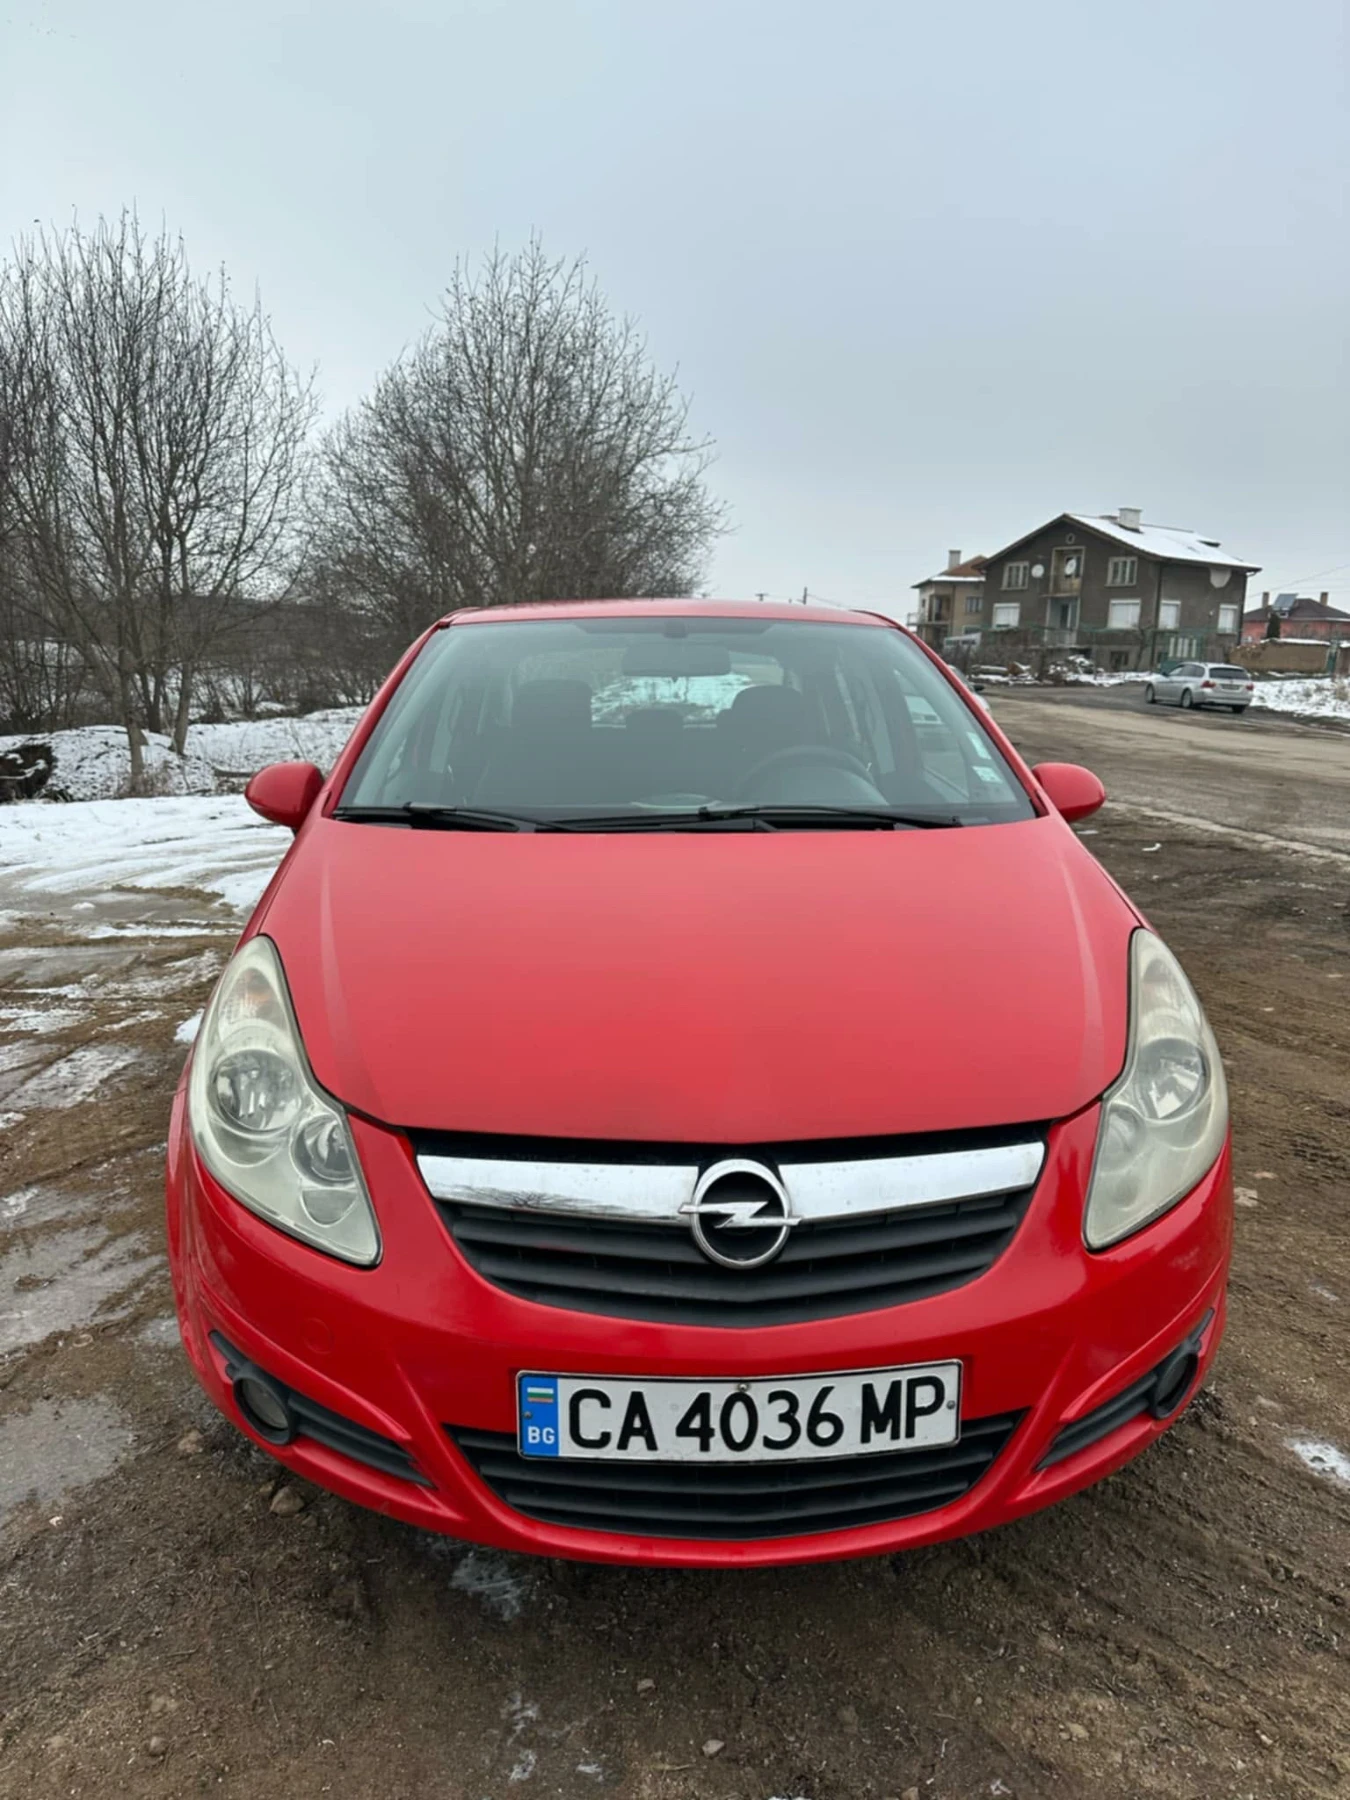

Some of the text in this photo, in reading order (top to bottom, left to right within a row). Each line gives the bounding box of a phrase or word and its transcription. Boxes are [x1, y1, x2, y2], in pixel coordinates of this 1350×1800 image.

[527, 1426, 556, 1445] BG
[569, 1375, 946, 1452] CA 4036 MP
